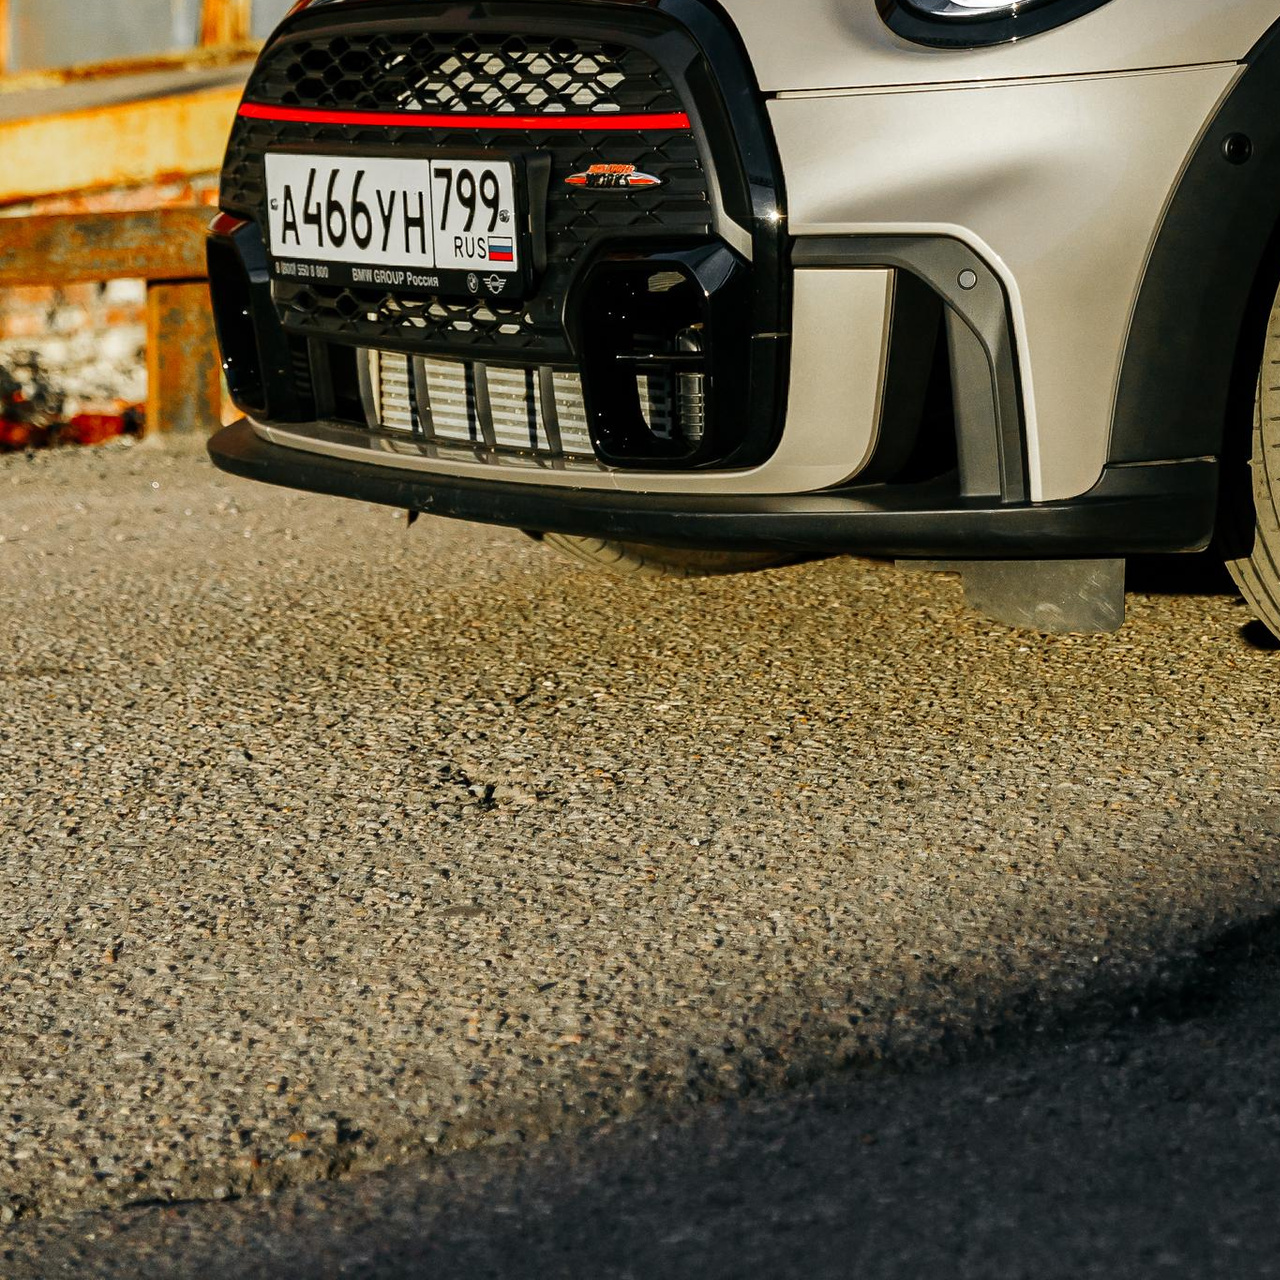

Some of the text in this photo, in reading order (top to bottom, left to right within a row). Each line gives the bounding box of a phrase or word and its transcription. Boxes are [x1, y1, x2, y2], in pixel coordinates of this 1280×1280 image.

[434, 168, 500, 232] 799
[454, 236, 487, 259] RUS
[352, 267, 439, 287] BMW GROUP Россия
